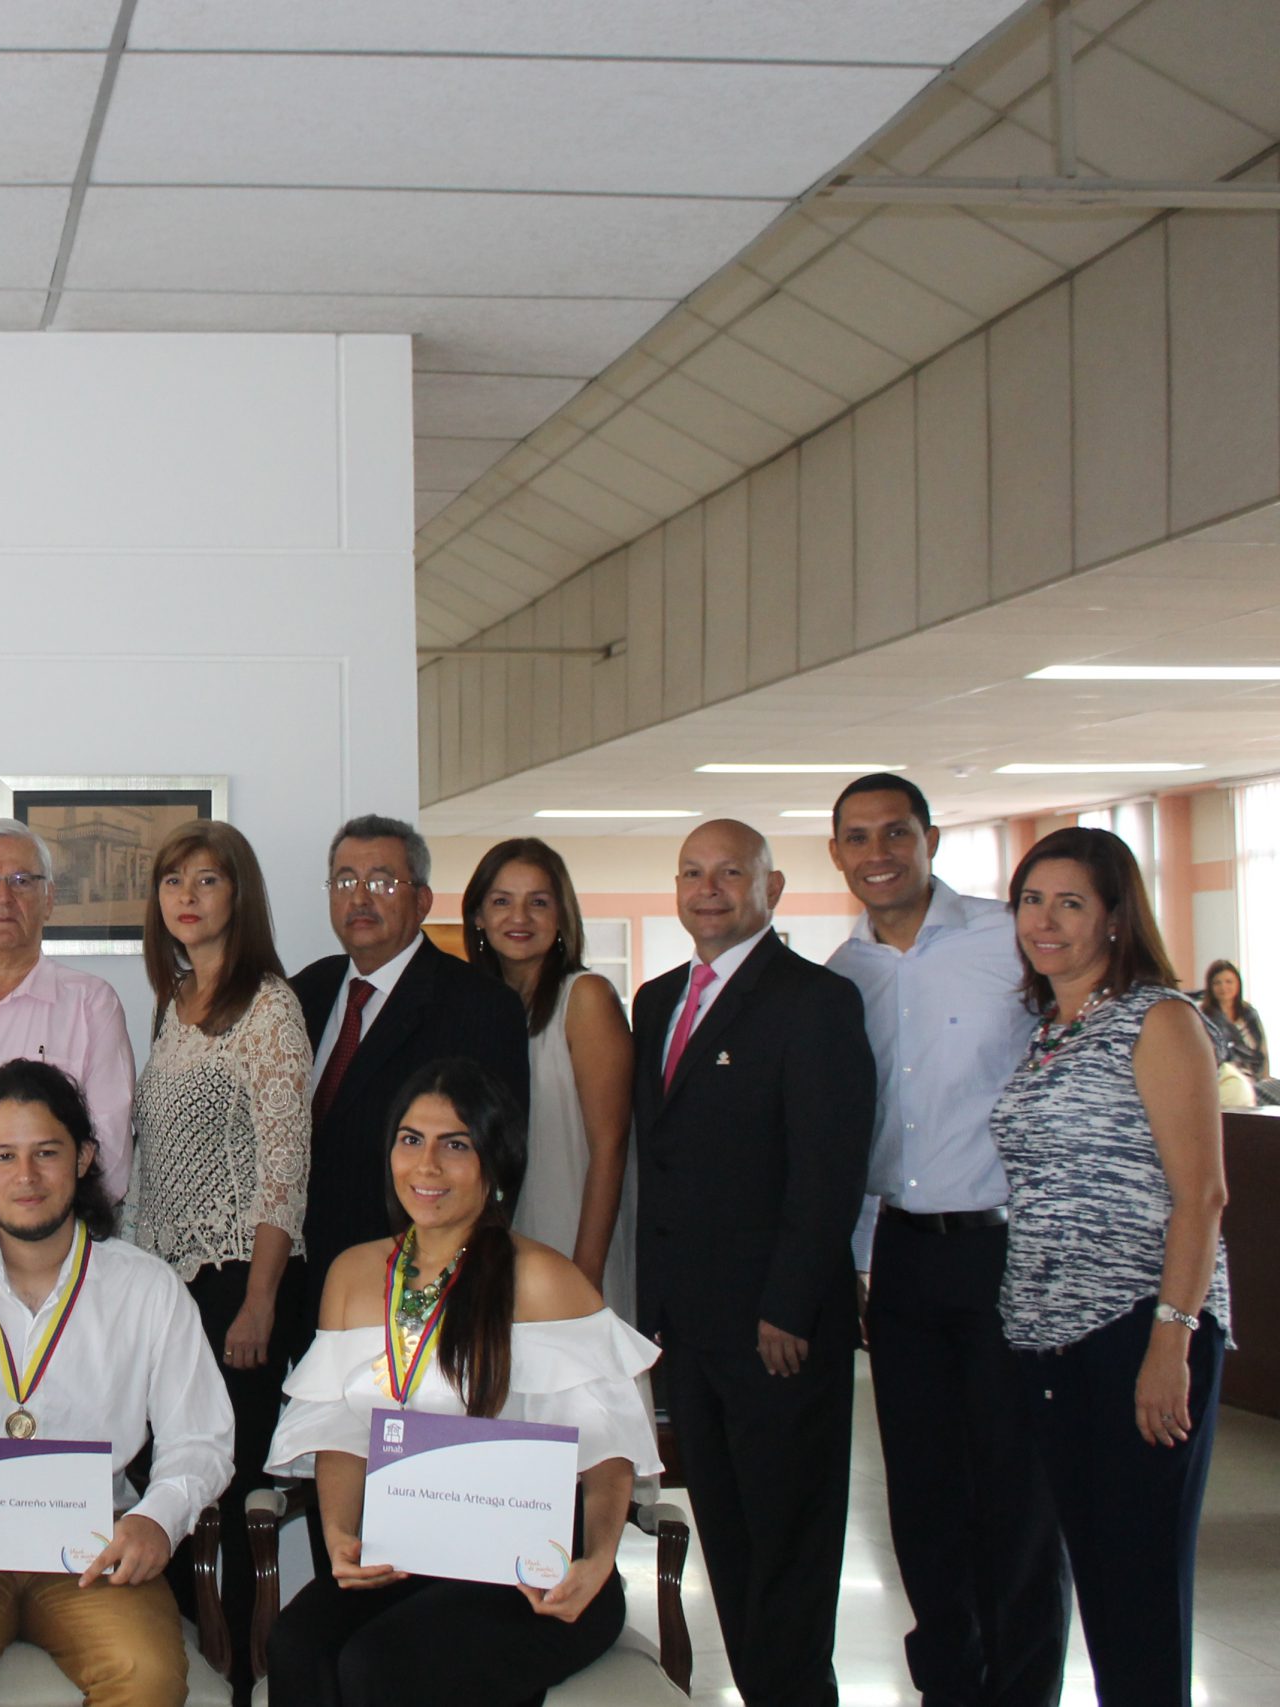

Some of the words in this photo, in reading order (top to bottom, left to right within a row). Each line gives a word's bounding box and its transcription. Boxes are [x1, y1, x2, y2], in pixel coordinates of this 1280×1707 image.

[382, 1444, 404, 1454] unab
[9, 1498, 47, 1509] Carreño
[387, 1485, 417, 1498] Laura
[418, 1488, 461, 1503] Marcela
[463, 1493, 506, 1507] Arteaga
[508, 1497, 552, 1511] Cuadros
